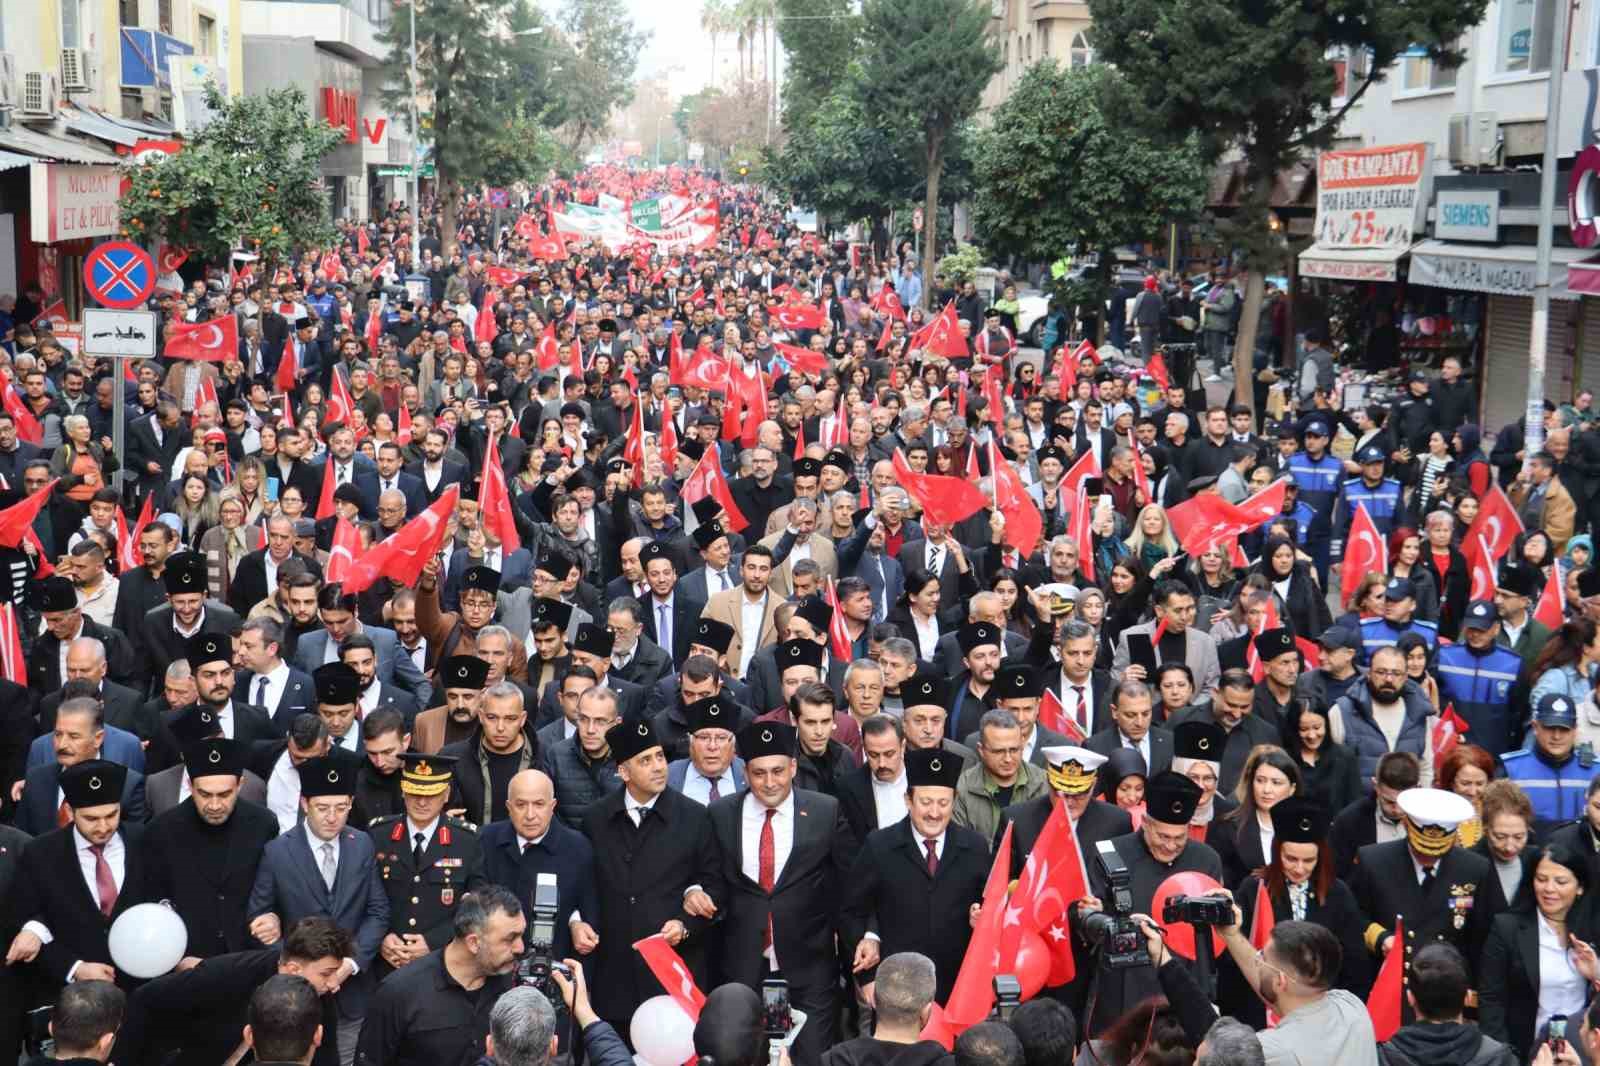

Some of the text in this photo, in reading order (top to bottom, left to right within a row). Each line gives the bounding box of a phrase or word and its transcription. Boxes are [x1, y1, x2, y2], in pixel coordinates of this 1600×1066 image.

[68, 175, 109, 193] MURAT
[63, 207, 77, 230] ET
[79, 208, 88, 228] &
[1441, 203, 1491, 226] SIEMENS
[1351, 209, 1377, 244] 25
